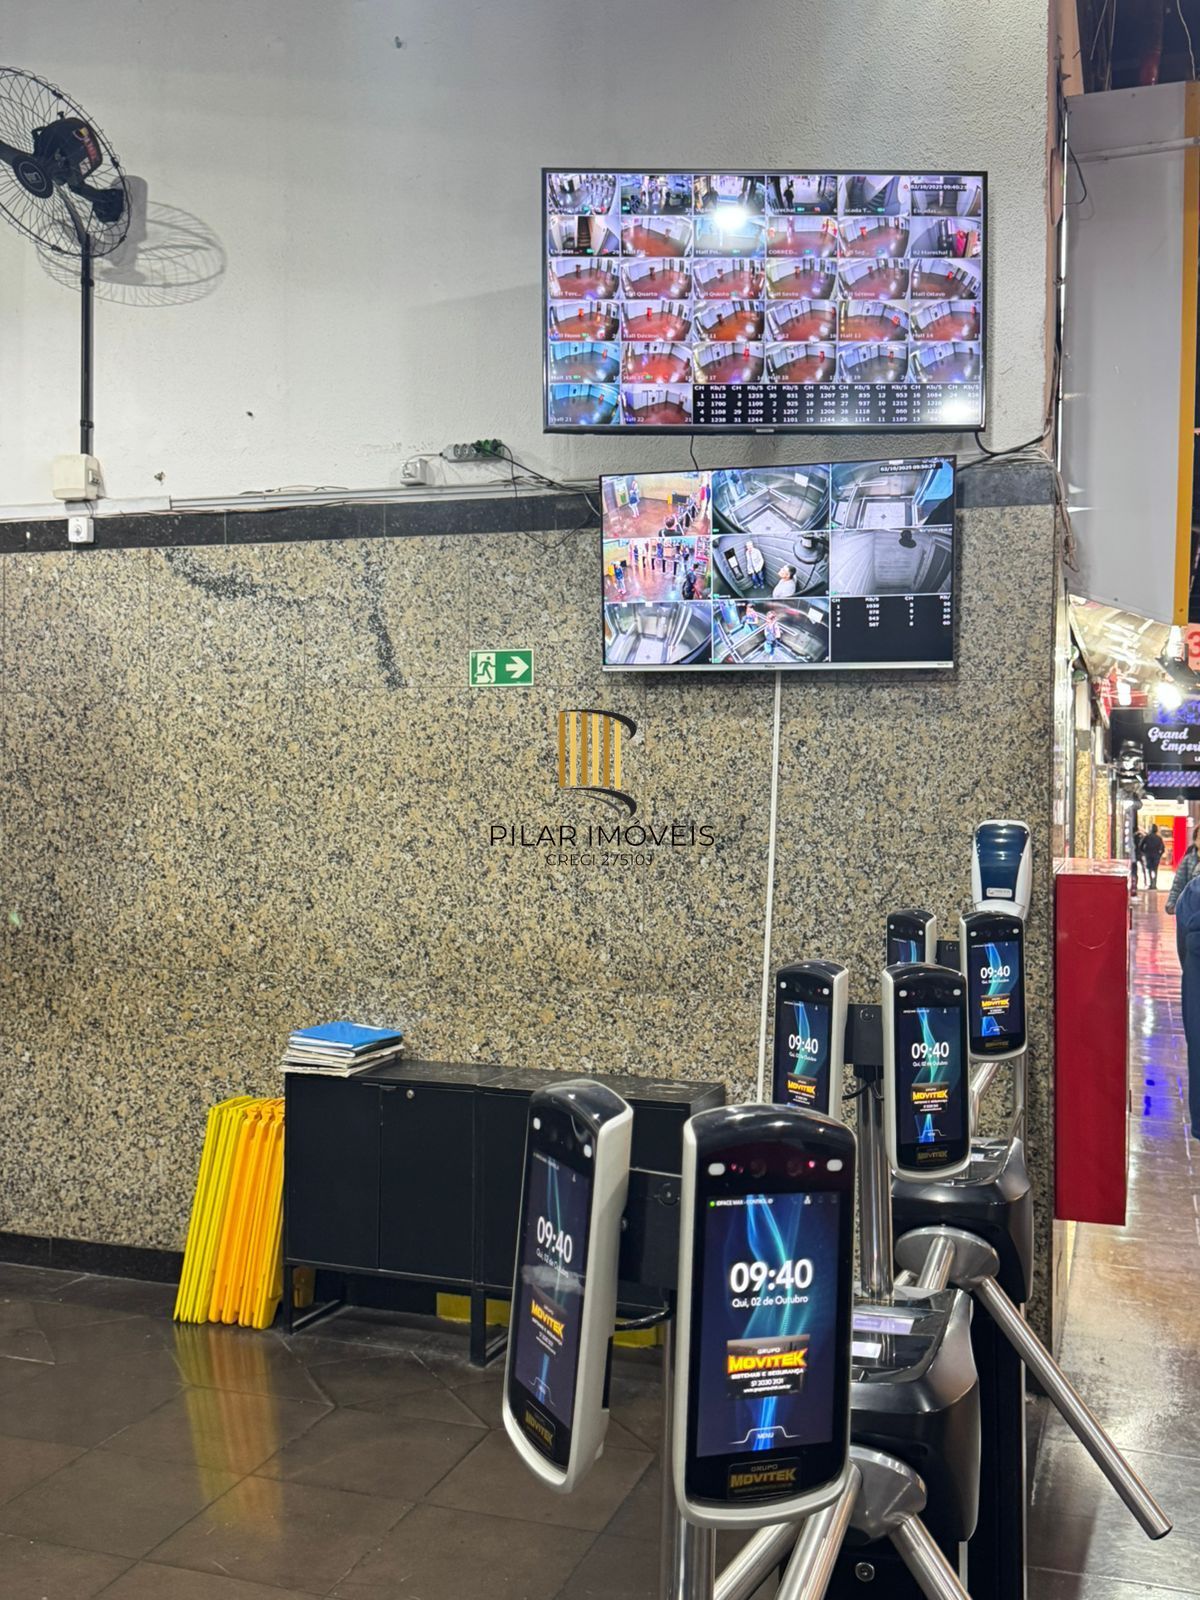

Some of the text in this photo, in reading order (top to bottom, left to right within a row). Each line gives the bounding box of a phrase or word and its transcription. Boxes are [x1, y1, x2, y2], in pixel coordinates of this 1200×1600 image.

[1148, 726, 1189, 742] Grand
[980, 965, 1010, 979] 09:40
[788, 1034, 818, 1054] 09:40
[911, 1042, 949, 1059] 09:40
[912, 1089, 948, 1100] MOVITEK
[537, 1216, 572, 1264] 09:40
[730, 1258, 813, 1293] 09:40
[732, 1294, 808, 1308] Qui, 02 de Outubro
[531, 1299, 565, 1338] MOVITEK
[728, 1347, 808, 1376] MOVITEK
[751, 1464, 778, 1472] GRUPO
[730, 1467, 797, 1488] MOVITEK
